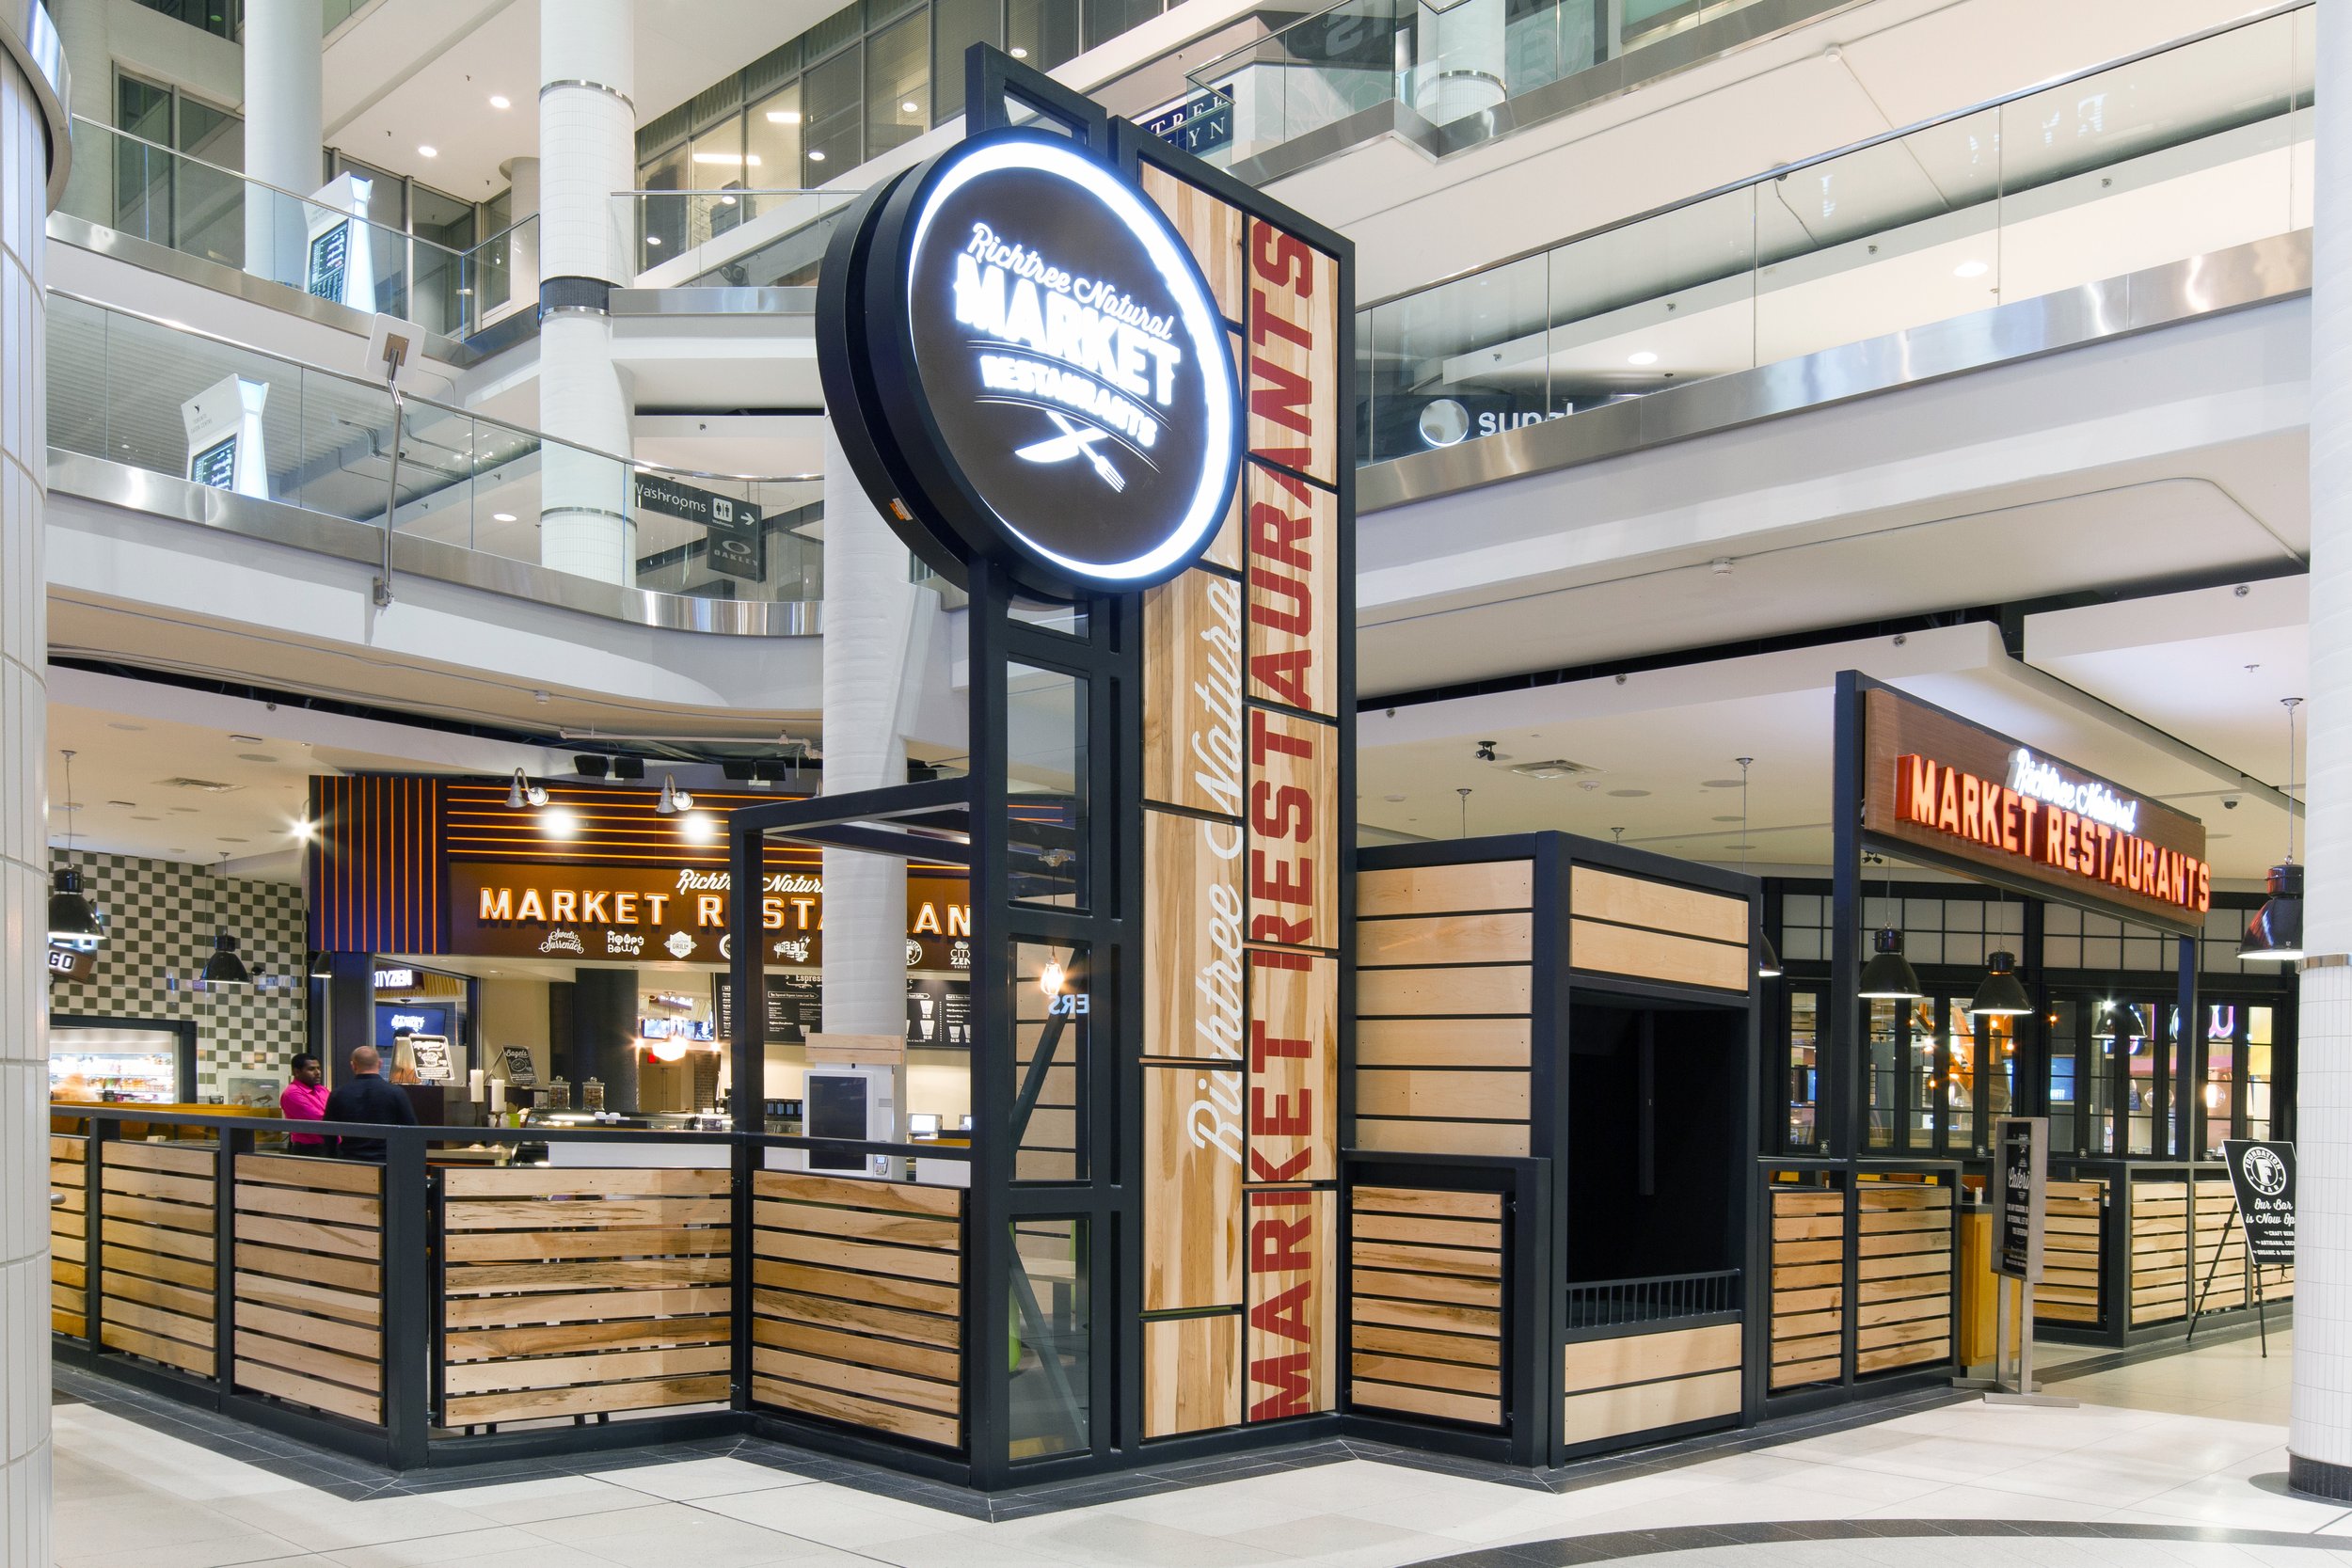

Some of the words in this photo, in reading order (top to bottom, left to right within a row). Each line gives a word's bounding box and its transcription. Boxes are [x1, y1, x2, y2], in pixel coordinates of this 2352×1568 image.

[972, 222, 1072, 293] Richtree
[1073, 277, 1174, 341] Natural
[952, 252, 1181, 406] MARKET
[979, 355, 1158, 448] RESTAURANTS
[1250, 221, 1313, 973] RESTAURANTS
[1908, 753, 2038, 858] MARKET
[2045, 803, 2212, 914] RESTAURANTS
[2011, 748, 2076, 812] Richtree
[2075, 783, 2137, 833] Natural
[479, 887, 670, 927] MARKET
[49, 951, 75, 971] GO
[1187, 883, 1243, 1165] Richtree
[2245, 1148, 2281, 1170] FOUNDATION
[2254, 1198, 2272, 1211] Our
[2273, 1198, 2294, 1211] Bar
[1250, 1020, 1311, 1422] MARKET
[2246, 1213, 2254, 1224] is
[2255, 1212, 2281, 1225] Now
